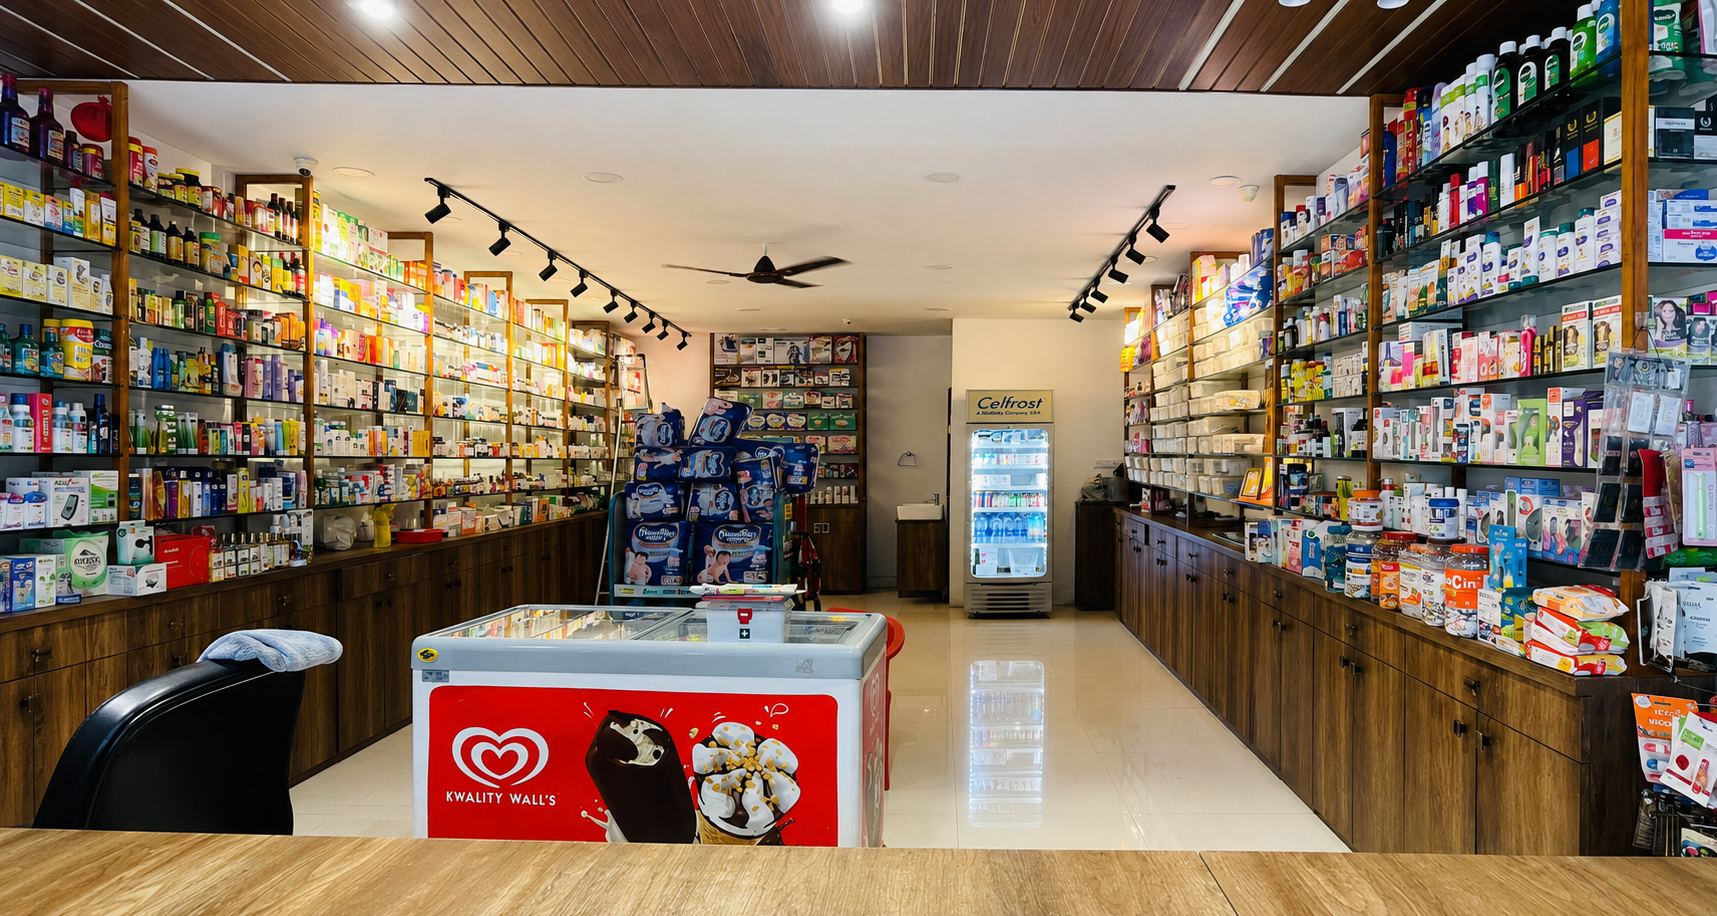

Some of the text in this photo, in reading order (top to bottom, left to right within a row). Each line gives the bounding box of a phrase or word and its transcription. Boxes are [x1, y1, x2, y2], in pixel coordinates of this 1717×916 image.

[977, 396, 1043, 410] Celfrost
[446, 791, 556, 806] KWALITY WALL'S
